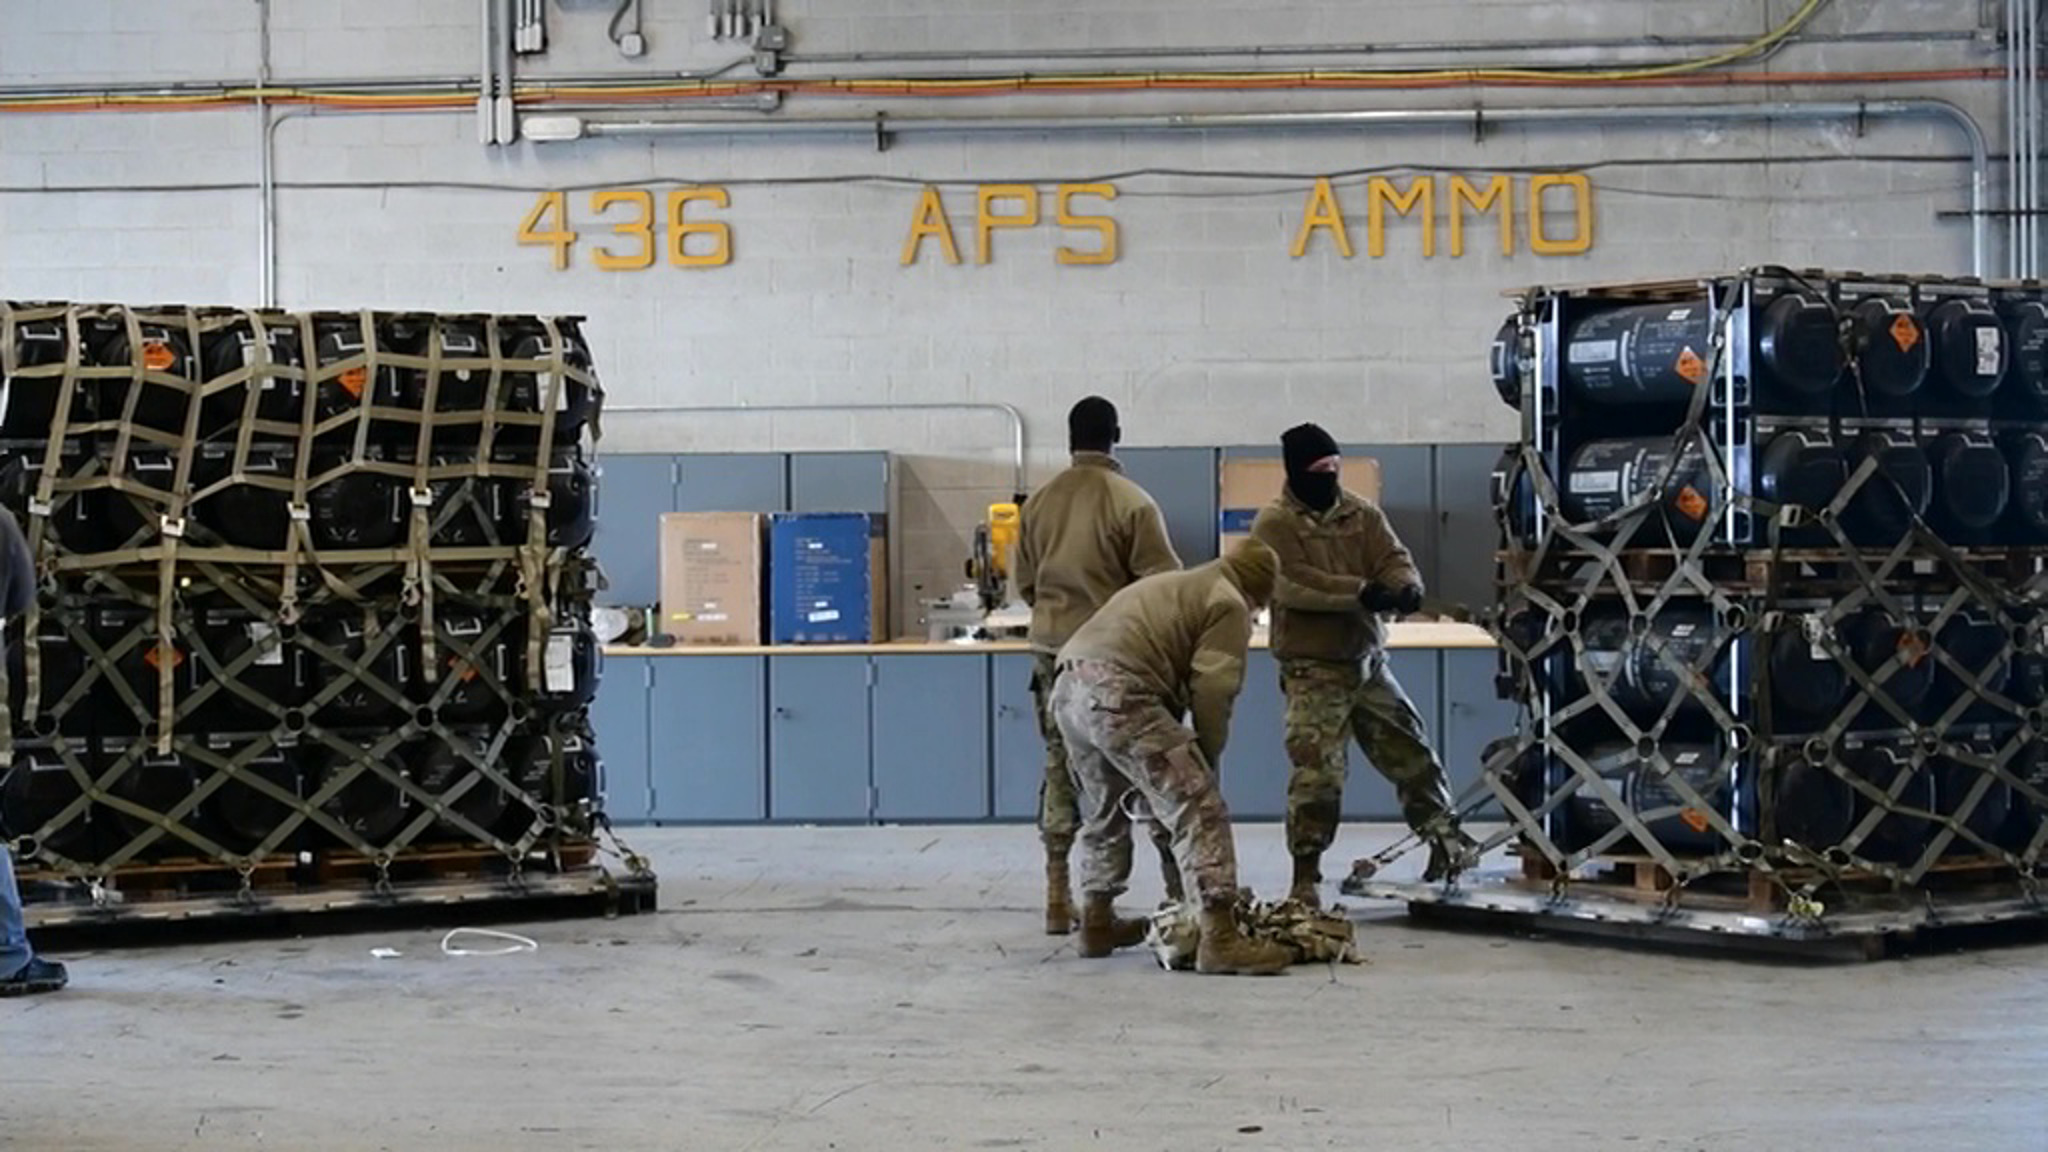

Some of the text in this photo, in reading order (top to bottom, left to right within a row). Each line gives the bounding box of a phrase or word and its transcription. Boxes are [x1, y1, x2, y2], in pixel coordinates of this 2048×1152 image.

[518, 174, 1594, 270] 436 APS AMMO
